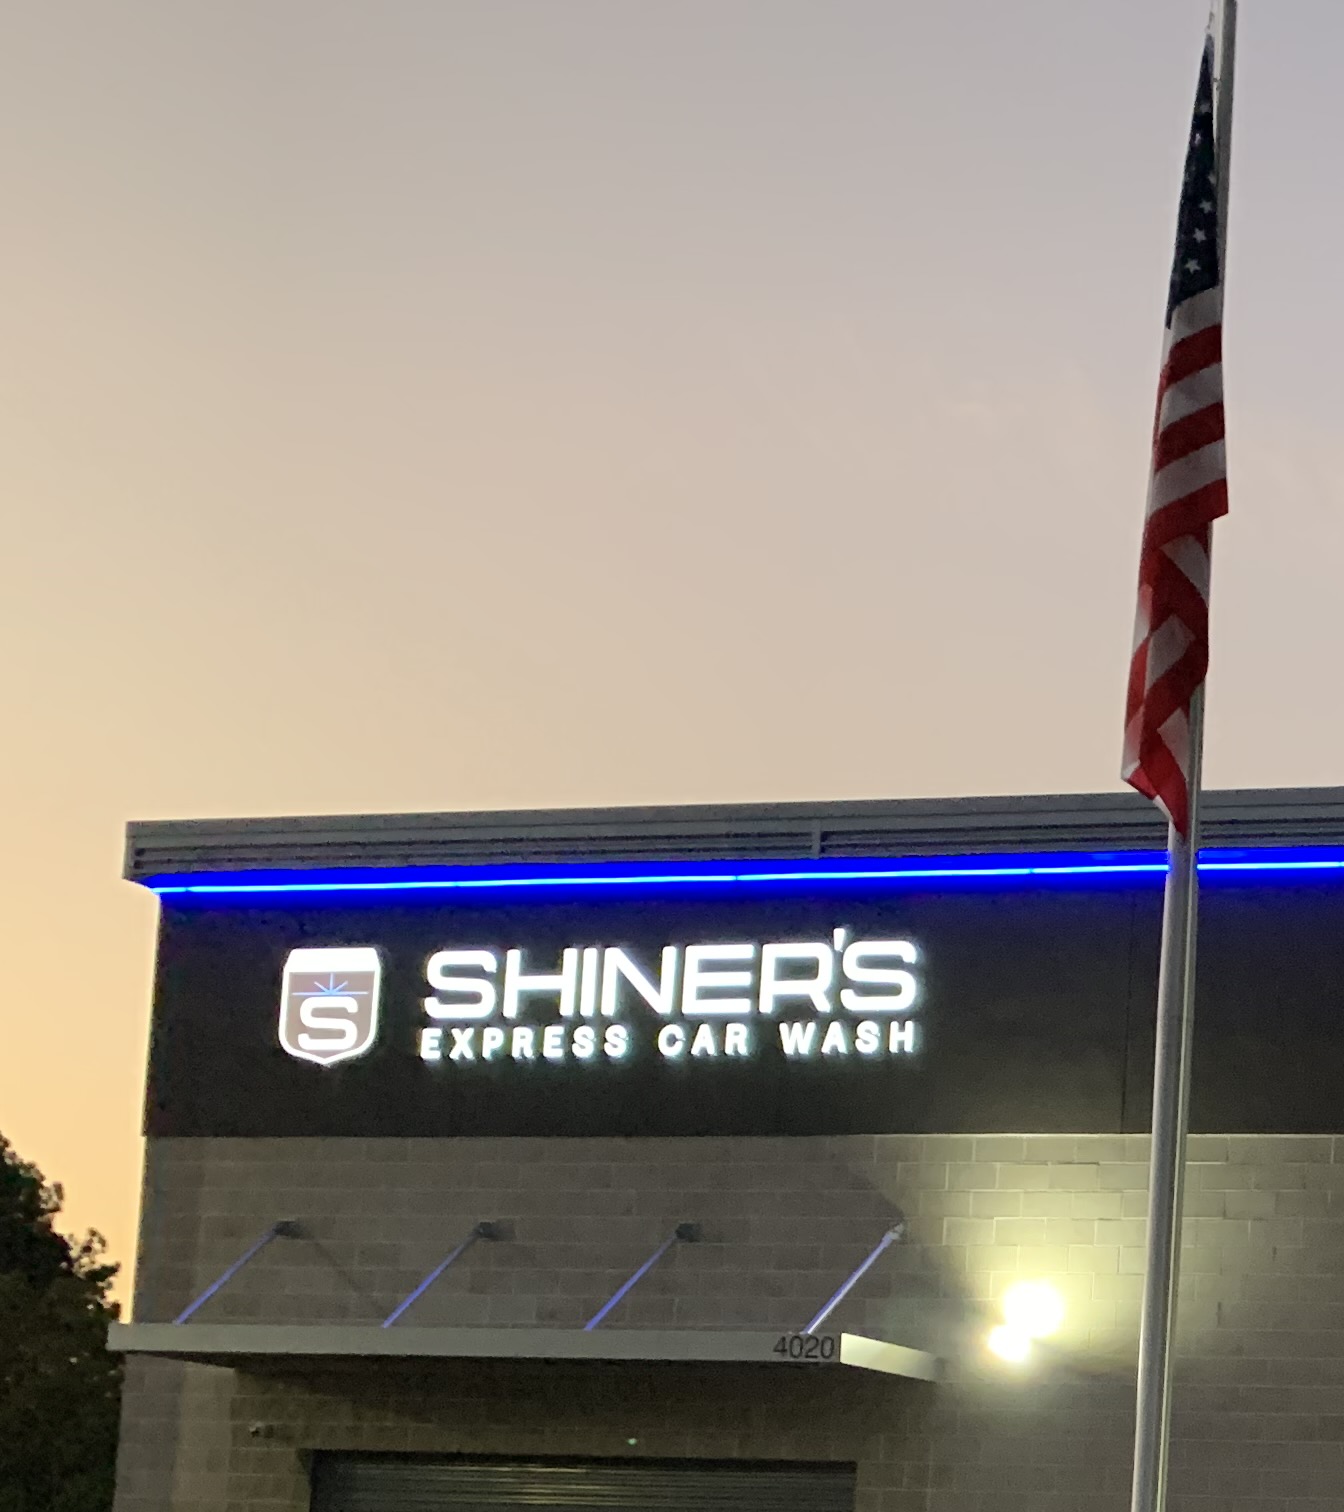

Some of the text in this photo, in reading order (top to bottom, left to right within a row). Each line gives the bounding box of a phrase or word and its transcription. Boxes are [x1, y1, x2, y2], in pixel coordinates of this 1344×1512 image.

[423, 928, 918, 1020] SHINER'S
[298, 996, 359, 1051] S
[420, 1019, 916, 1060] EXPRESS CAR WASH
[773, 1335, 835, 1359] 4020
